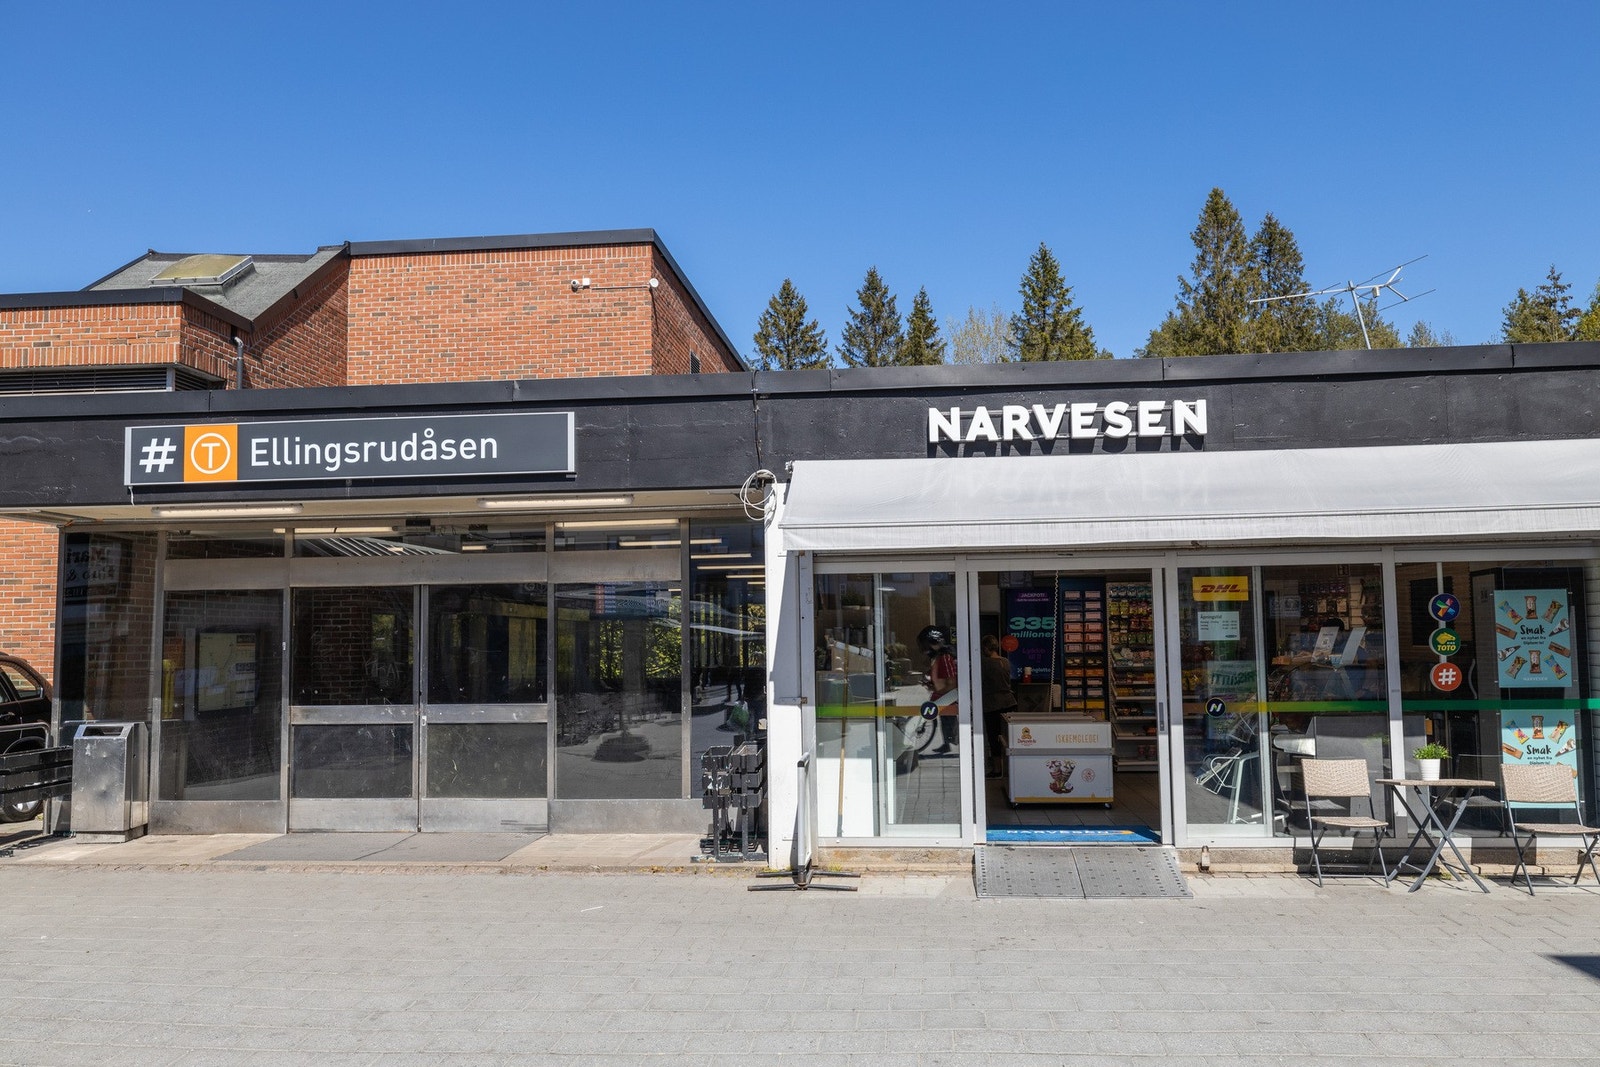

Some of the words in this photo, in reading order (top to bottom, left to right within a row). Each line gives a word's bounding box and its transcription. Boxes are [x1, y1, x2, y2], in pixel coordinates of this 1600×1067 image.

[928, 399, 1208, 442] NARVESEN
[250, 428, 498, 472] Ellingsrudåsen
[1200, 584, 1240, 593] DHL
[1009, 616, 1055, 630] 335
[1520, 624, 1546, 635] Smak
[1526, 744, 1552, 755] Smak
